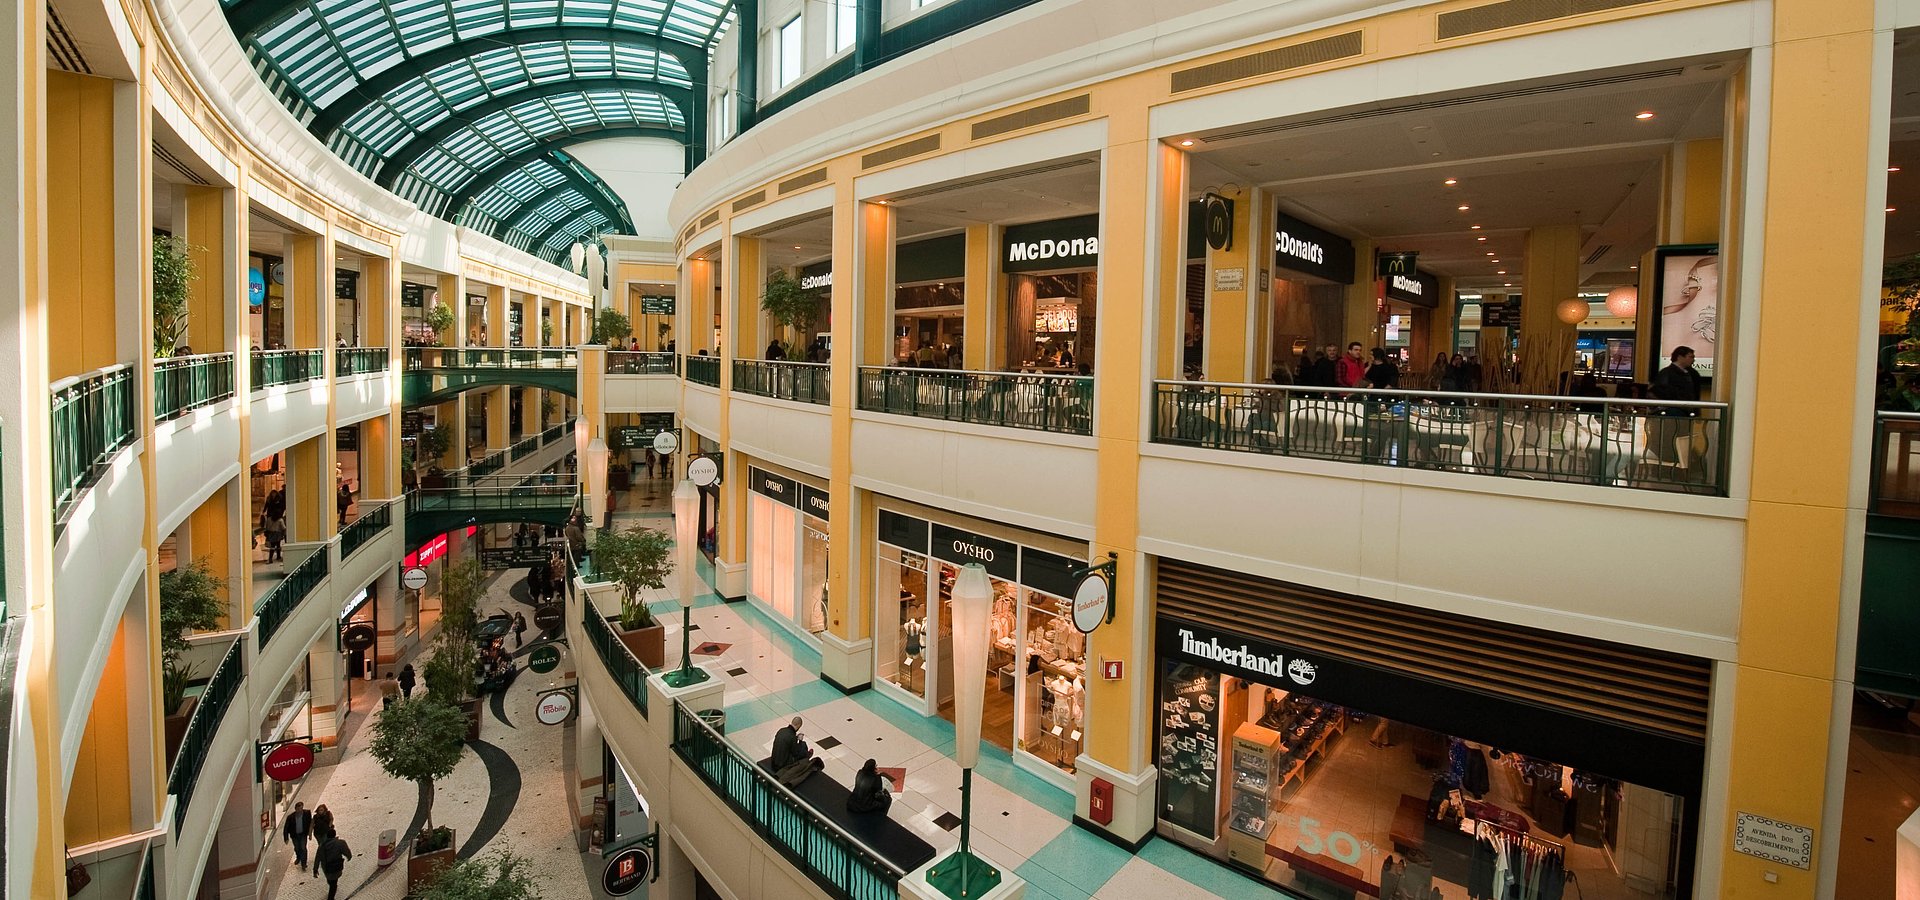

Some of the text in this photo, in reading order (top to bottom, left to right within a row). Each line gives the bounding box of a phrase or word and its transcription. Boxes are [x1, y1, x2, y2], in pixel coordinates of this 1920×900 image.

[1009, 237, 1099, 262] McDona
[690, 467, 716, 476] OYSHO
[765, 479, 784, 494] OYSHO
[419, 546, 433, 561] ZIPPY
[952, 539, 995, 562] OYSHO
[1178, 628, 1284, 678] Timberland
[532, 656, 557, 666] ROLEX
[543, 704, 567, 715] mobile
[272, 755, 306, 769] worten
[1296, 815, 1380, 866] 50%
[1751, 828, 1794, 844] AVENIDA DOS
[1745, 835, 1800, 855] DESCOBRIMENTOS
